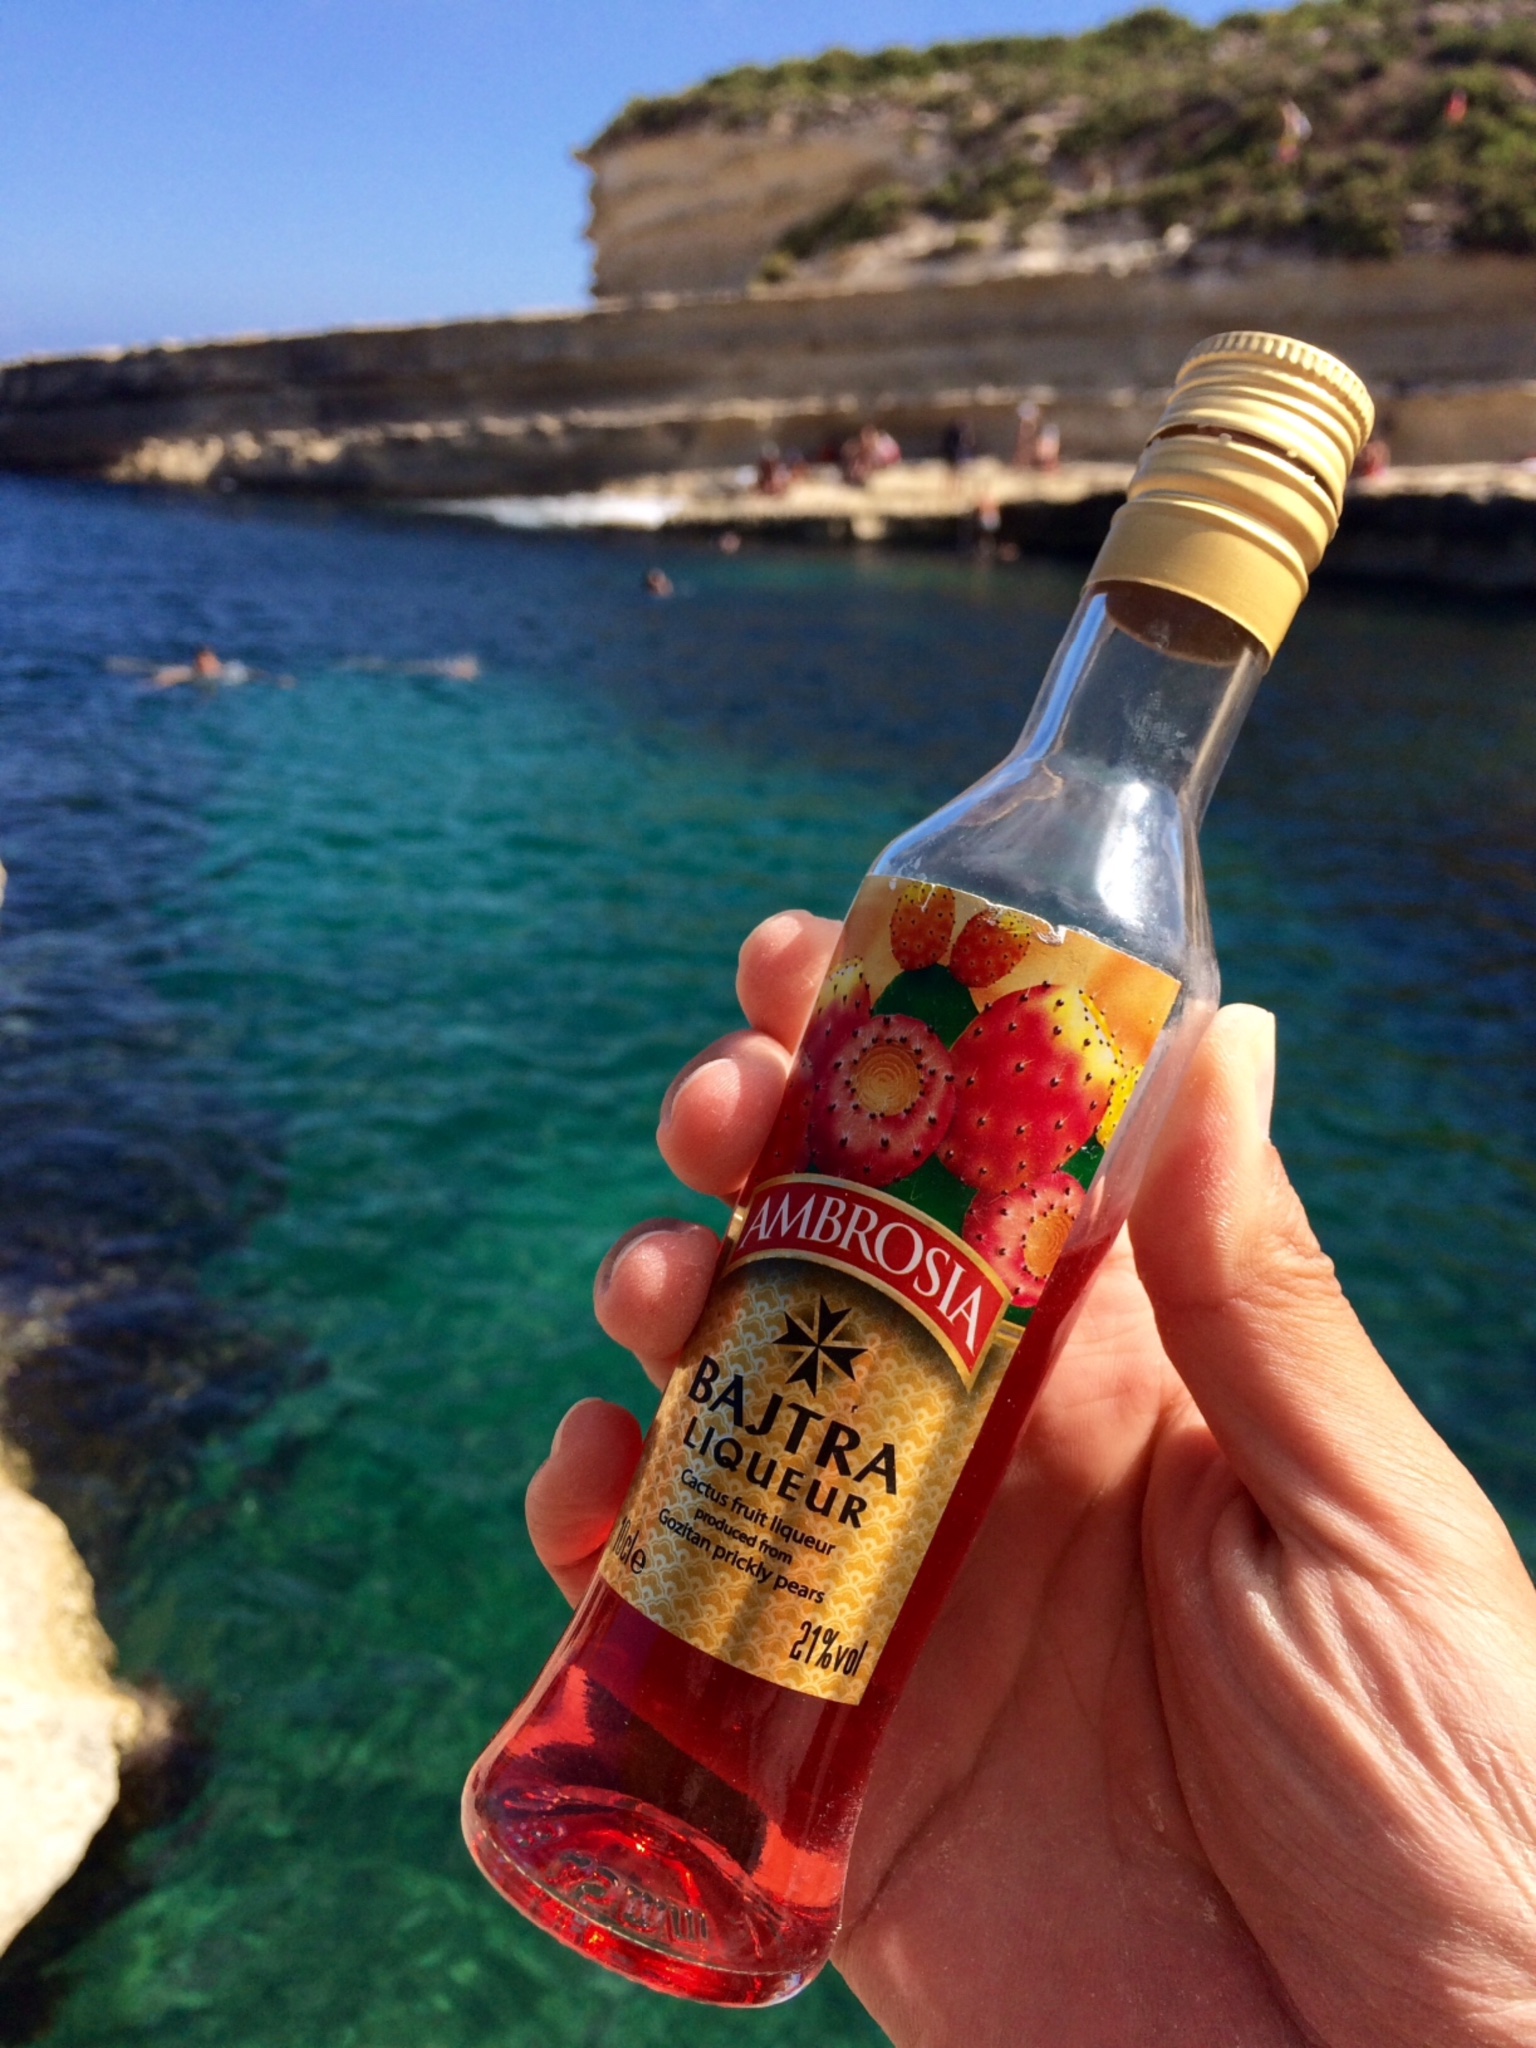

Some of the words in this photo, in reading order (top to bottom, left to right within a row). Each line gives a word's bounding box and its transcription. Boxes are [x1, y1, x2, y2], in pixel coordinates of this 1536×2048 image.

[740, 1192, 983, 1352] AMBROSIA
[683, 1416, 867, 1528] LIQUEUR
[689, 1355, 897, 1495] BAJTRA
[659, 1508, 711, 1552] Gozitan
[711, 1545, 773, 1584] prickly
[773, 1574, 825, 1604] pears
[681, 1469, 729, 1507] Cactus
[731, 1497, 768, 1528] fruit
[769, 1515, 836, 1556] liqueur
[694, 1508, 757, 1548] produced
[759, 1540, 793, 1565] from
